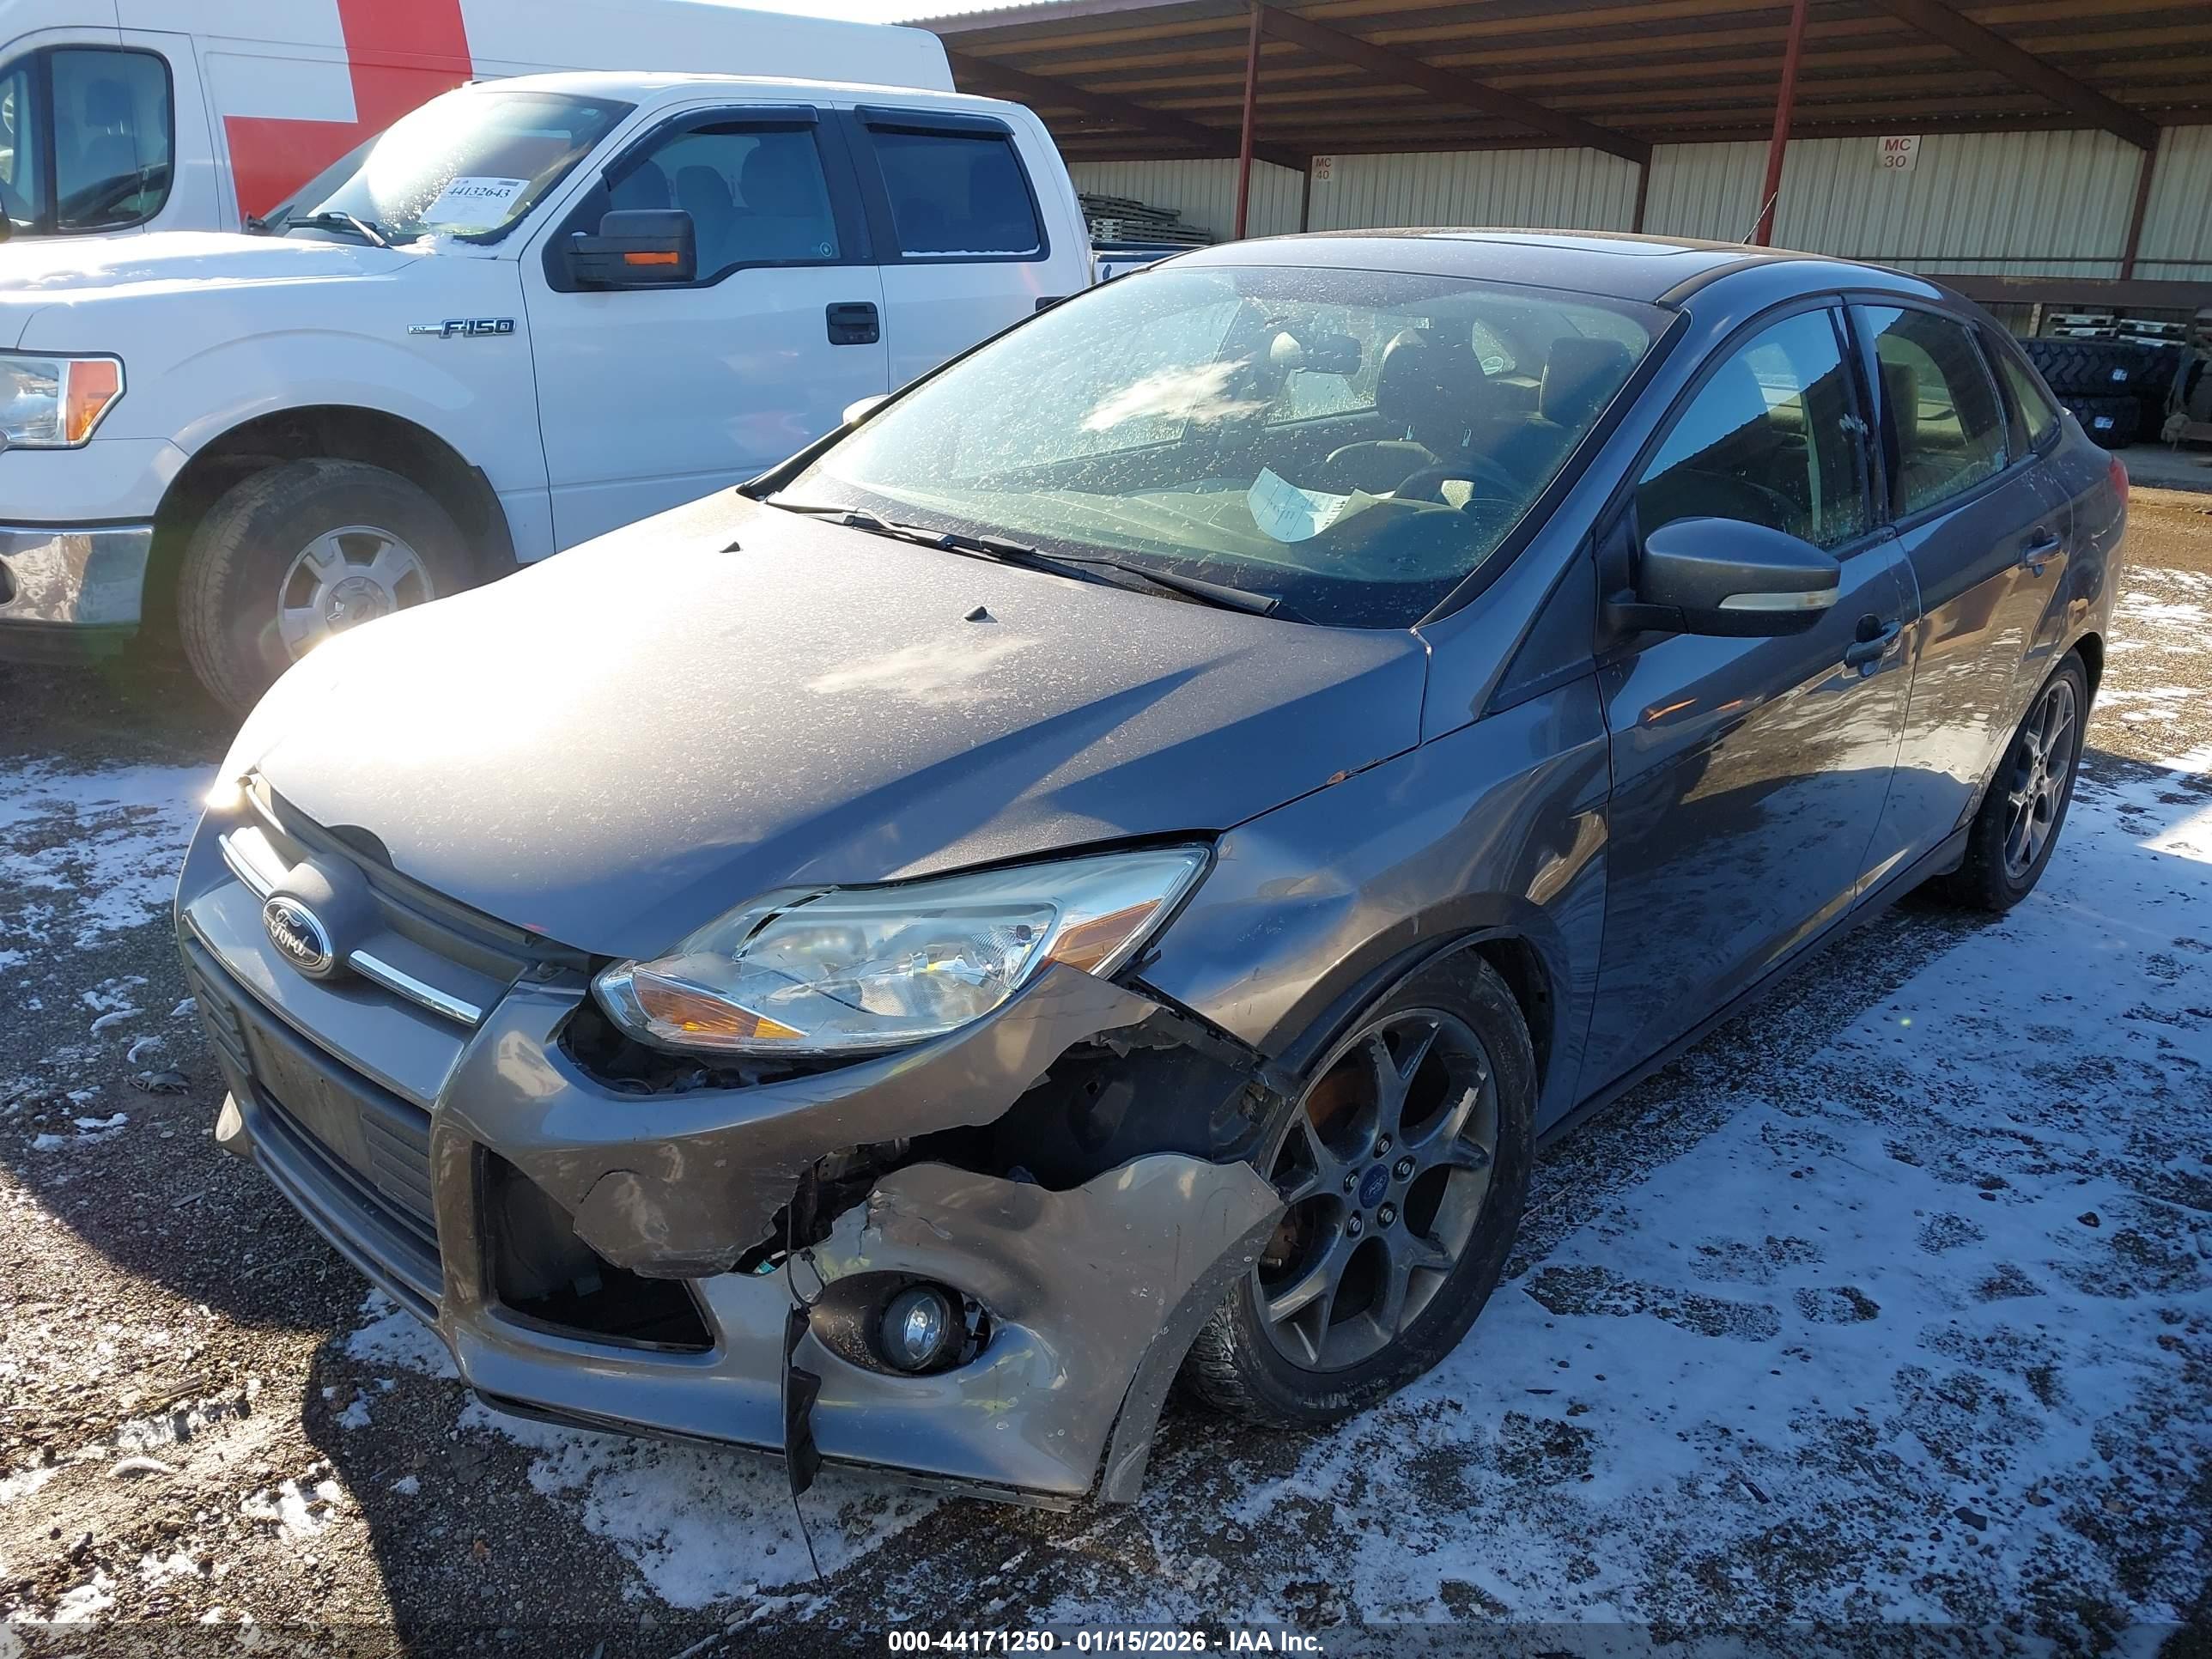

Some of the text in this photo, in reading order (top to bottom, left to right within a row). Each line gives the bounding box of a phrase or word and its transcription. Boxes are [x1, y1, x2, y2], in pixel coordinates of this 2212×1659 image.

[1884, 138, 1911, 151] MC
[1316, 157, 1332, 167] MC
[1884, 155, 1907, 168] 30
[448, 186, 511, 198] 44132643
[441, 319, 515, 336] F-150
[270, 908, 309, 957] Ford
